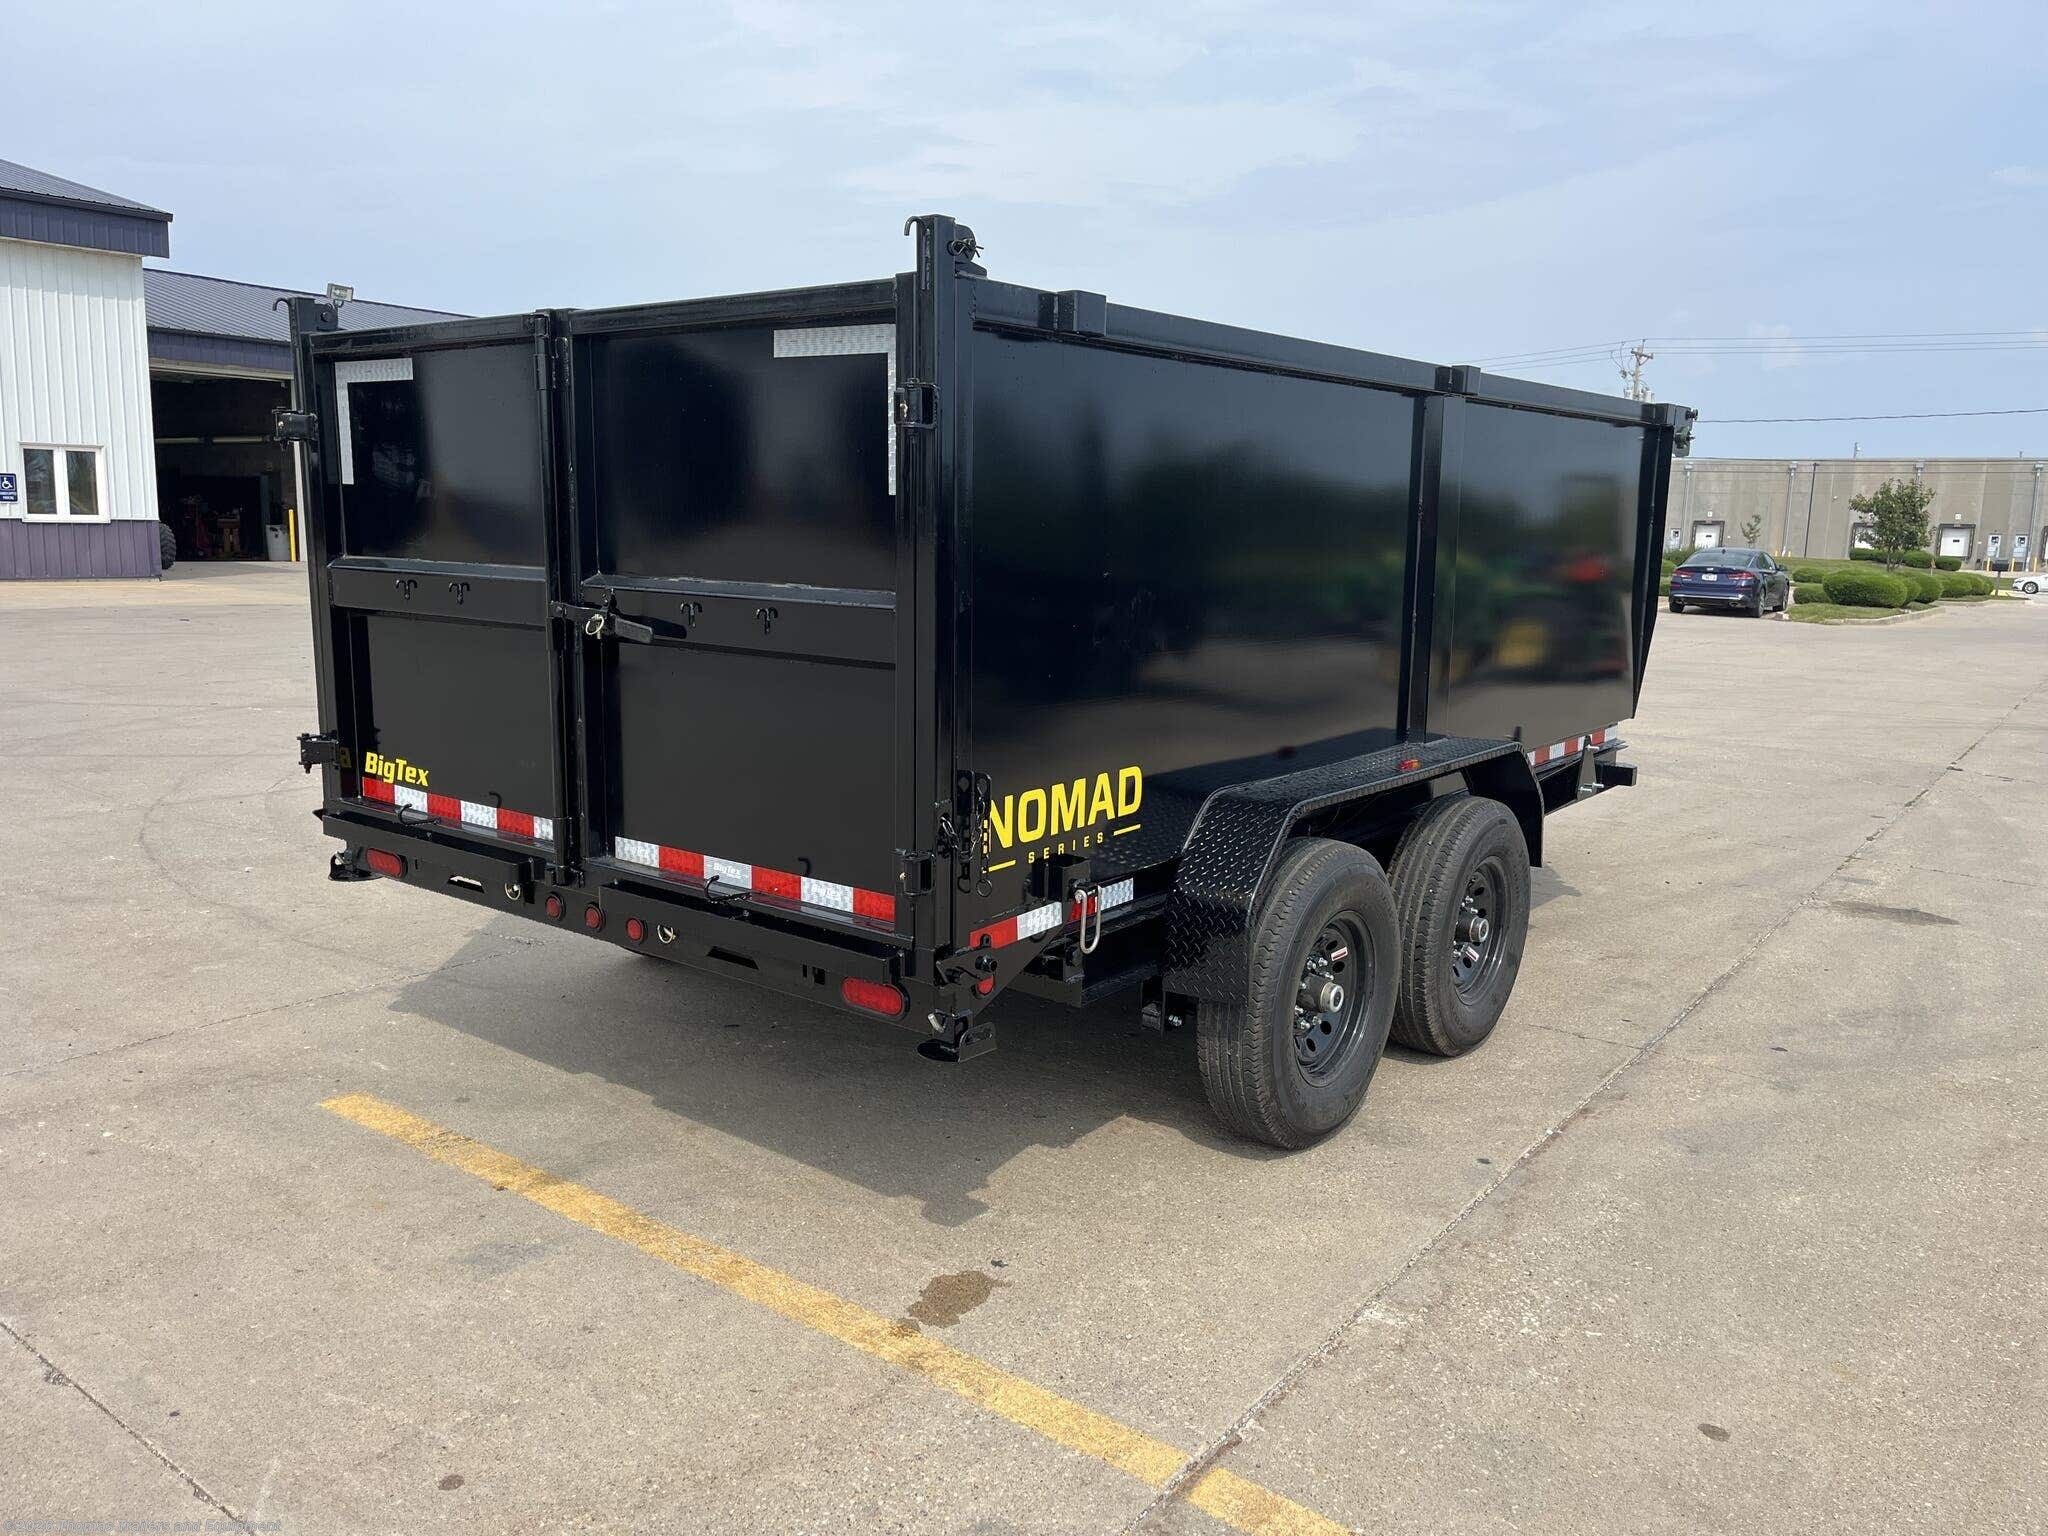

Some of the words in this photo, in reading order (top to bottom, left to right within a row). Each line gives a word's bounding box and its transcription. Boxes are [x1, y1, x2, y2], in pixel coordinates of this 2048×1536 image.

[364, 751, 430, 787] BigTex
[986, 765, 1143, 849] NOMAD
[1028, 832, 1104, 864] SERIES
